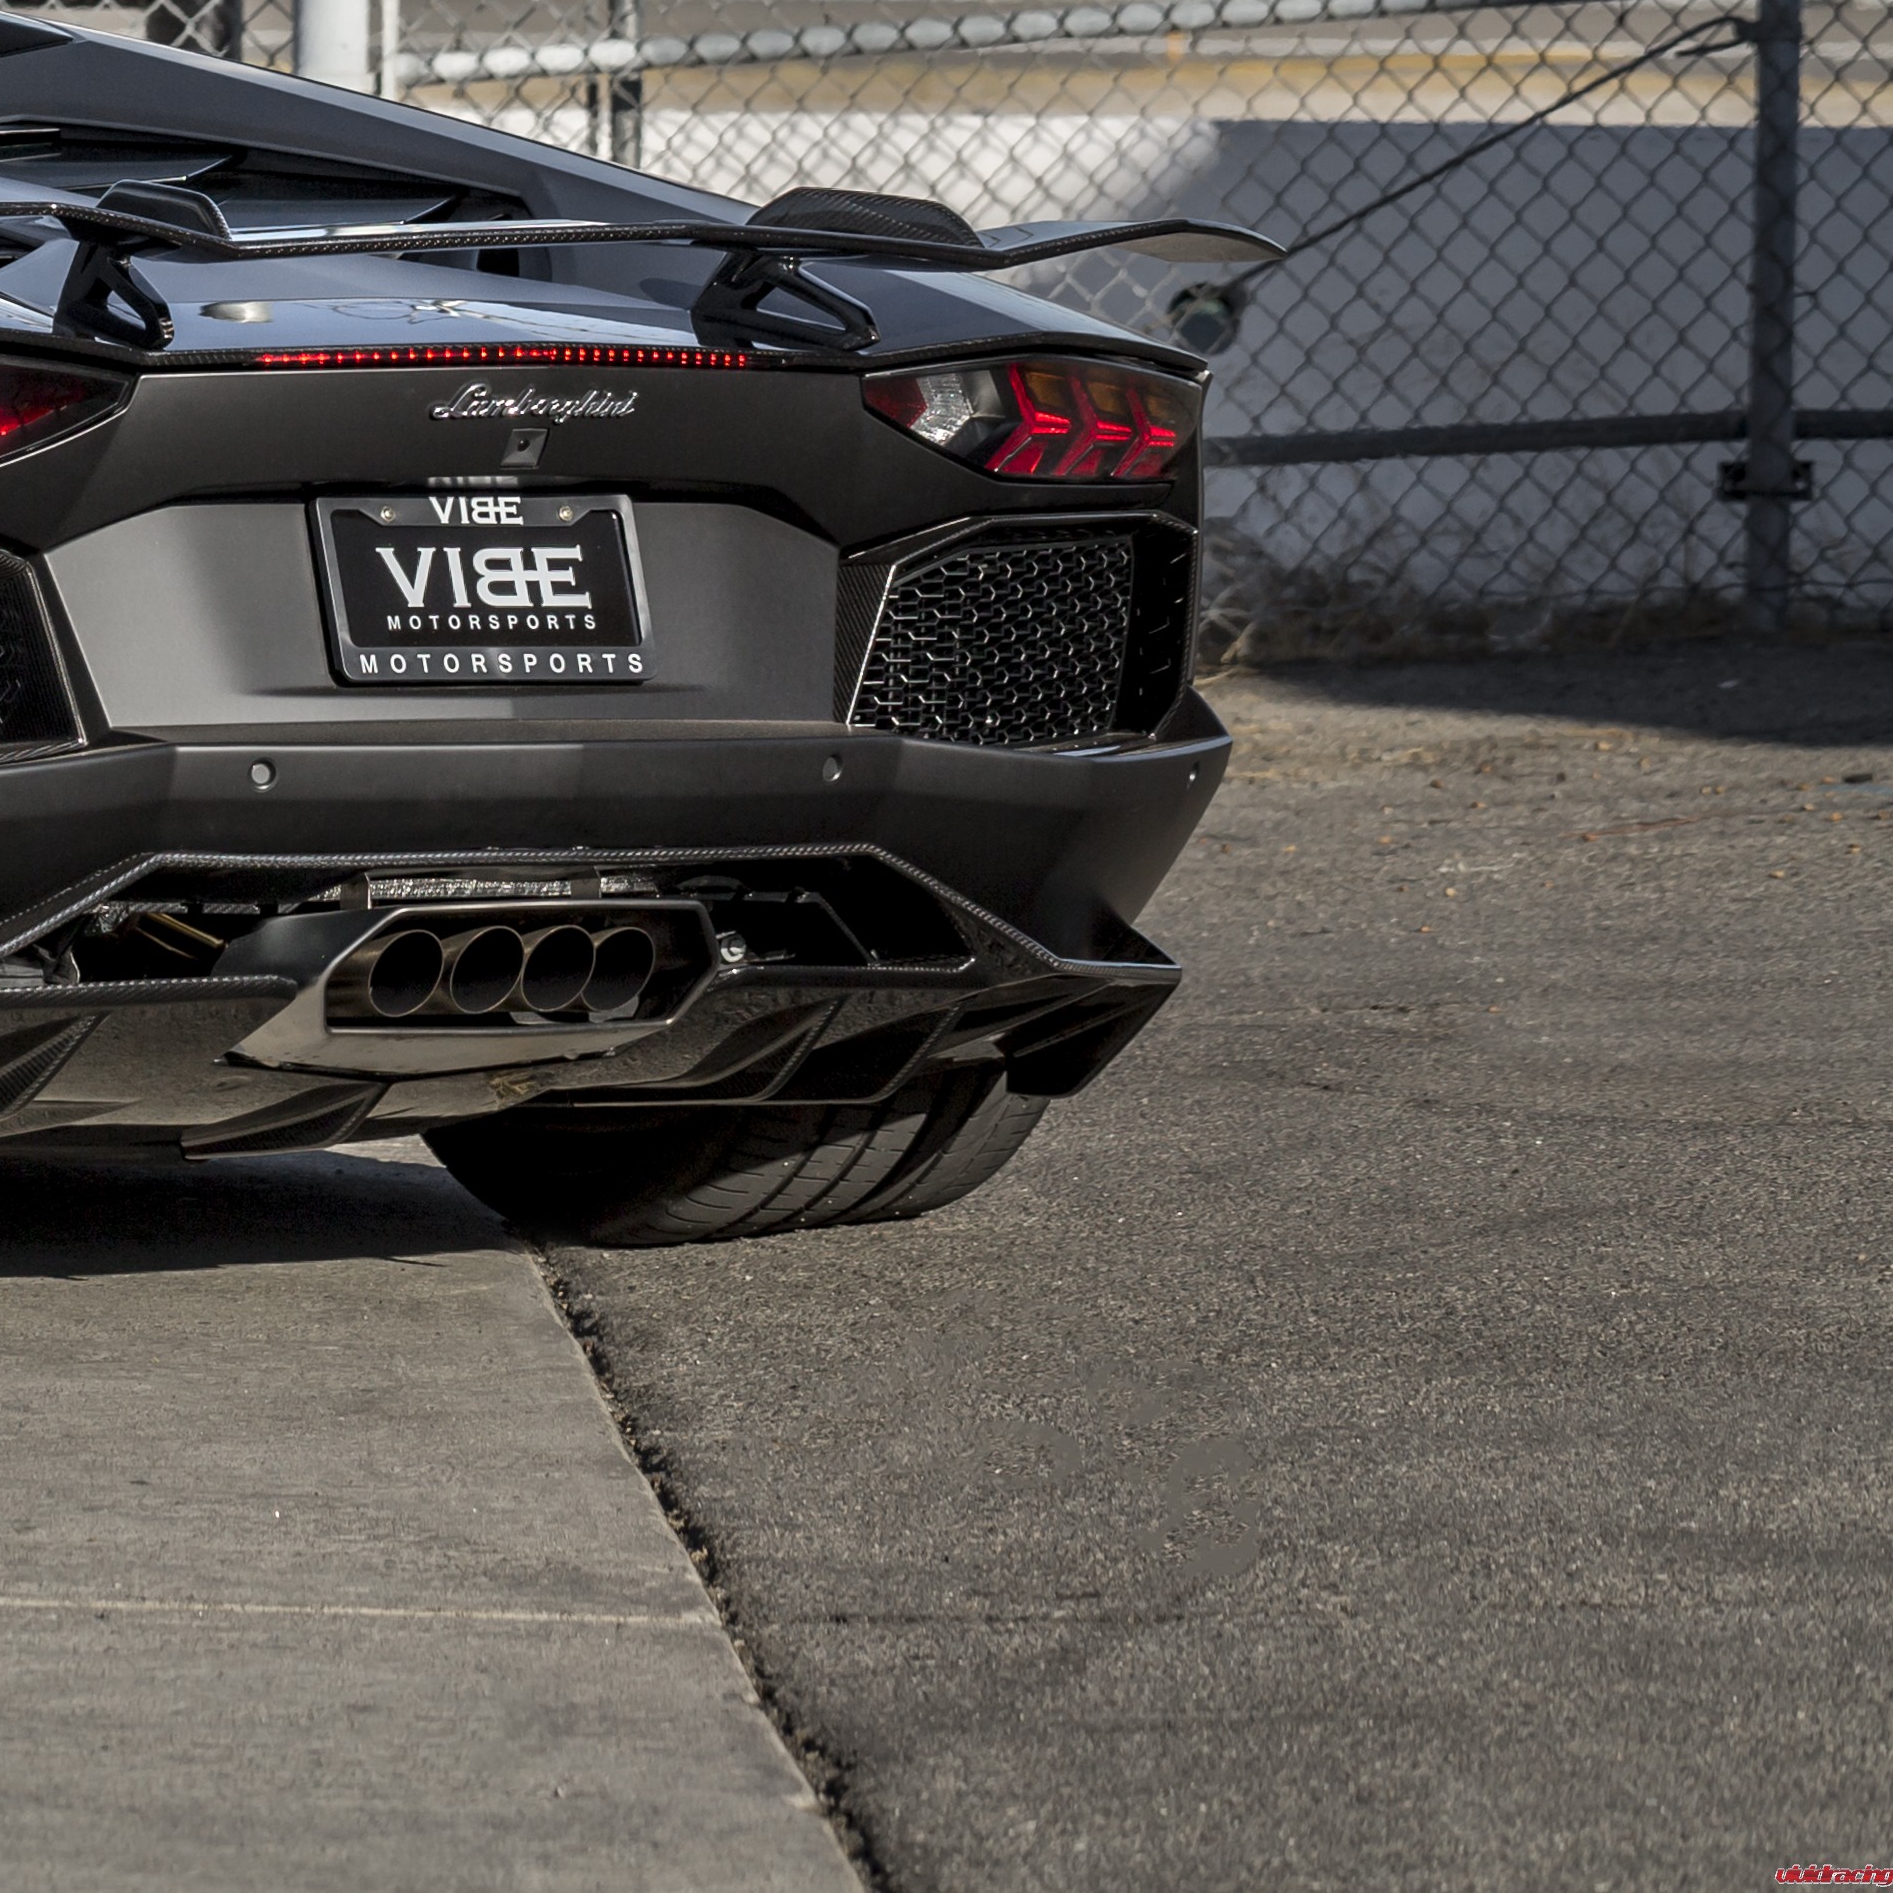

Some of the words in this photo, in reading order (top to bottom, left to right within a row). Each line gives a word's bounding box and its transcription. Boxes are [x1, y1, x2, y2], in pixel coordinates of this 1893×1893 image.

[431, 382, 638, 423] Lamborghini
[429, 495, 523, 525] VIBE
[375, 545, 592, 608] VIBE
[387, 614, 596, 630] MOTORSPORTS
[360, 653, 643, 674] MOTORSPORTS
